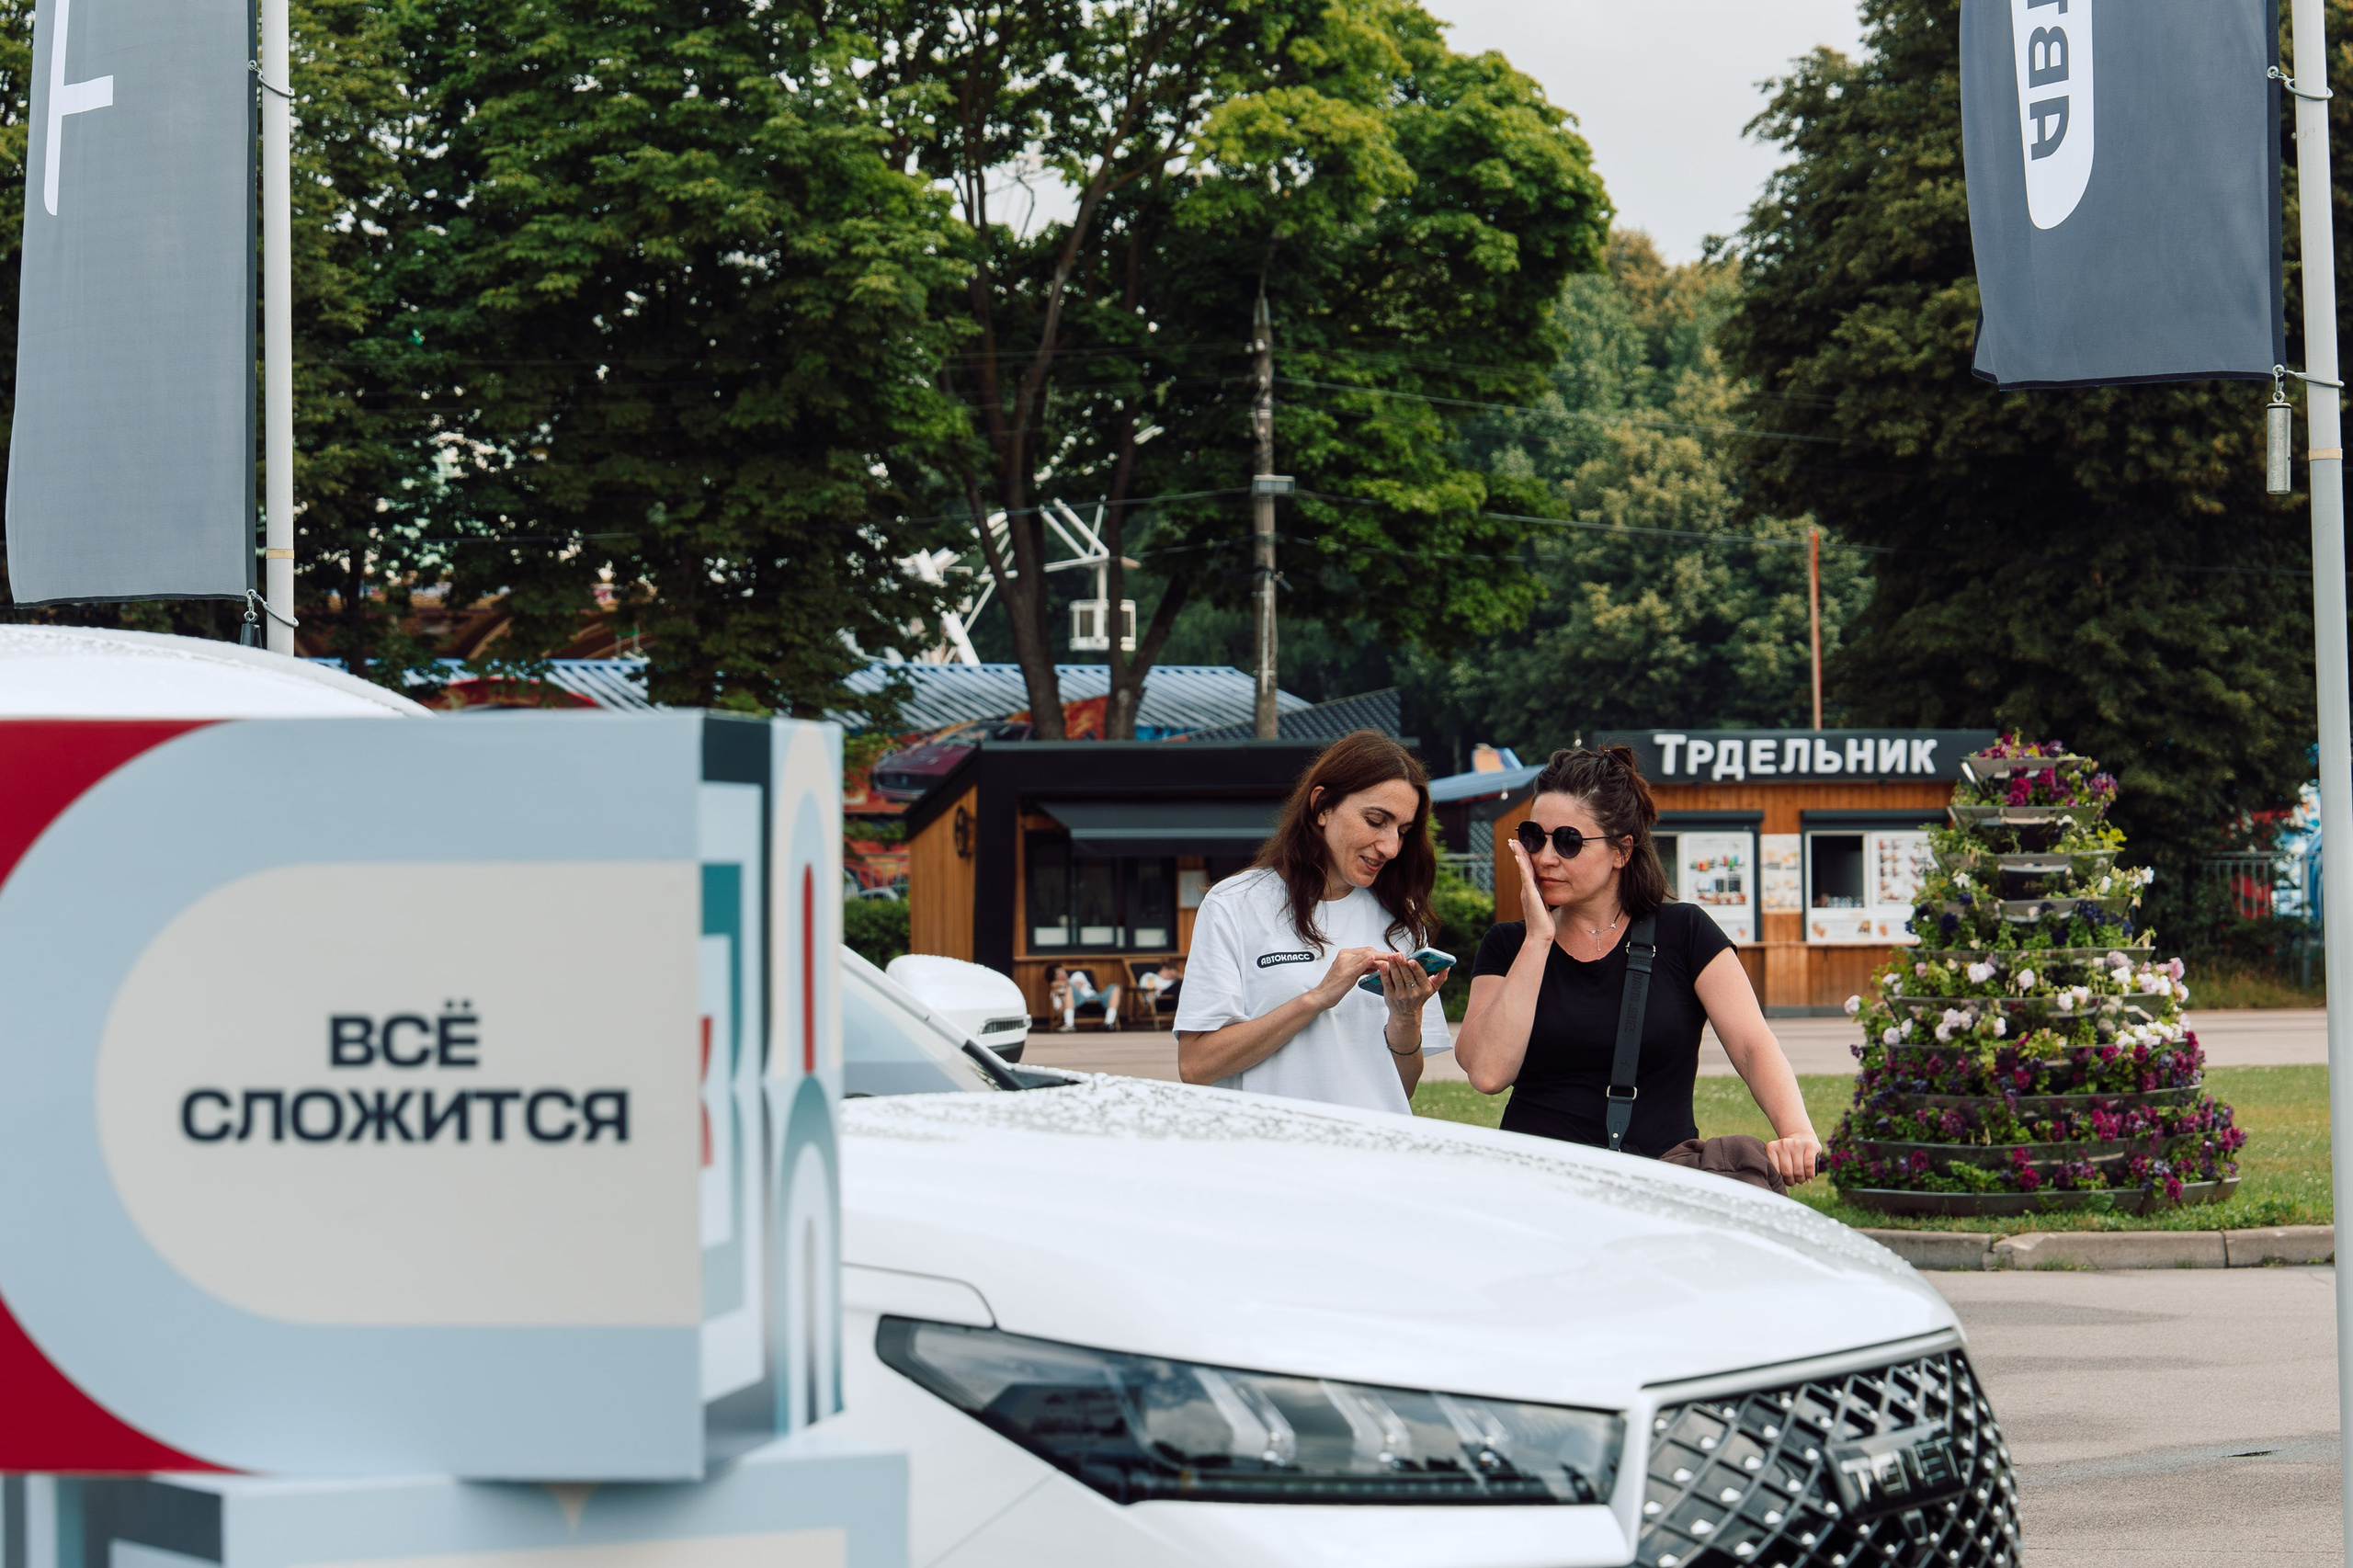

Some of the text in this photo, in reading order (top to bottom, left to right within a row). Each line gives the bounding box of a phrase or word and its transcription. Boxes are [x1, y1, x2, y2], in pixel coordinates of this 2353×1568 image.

[1260, 953, 1312, 966] АВТОКЛАСС
[328, 999, 480, 1068] ВСЁ
[180, 1088, 631, 1143] СЛОЖИТСЯ
